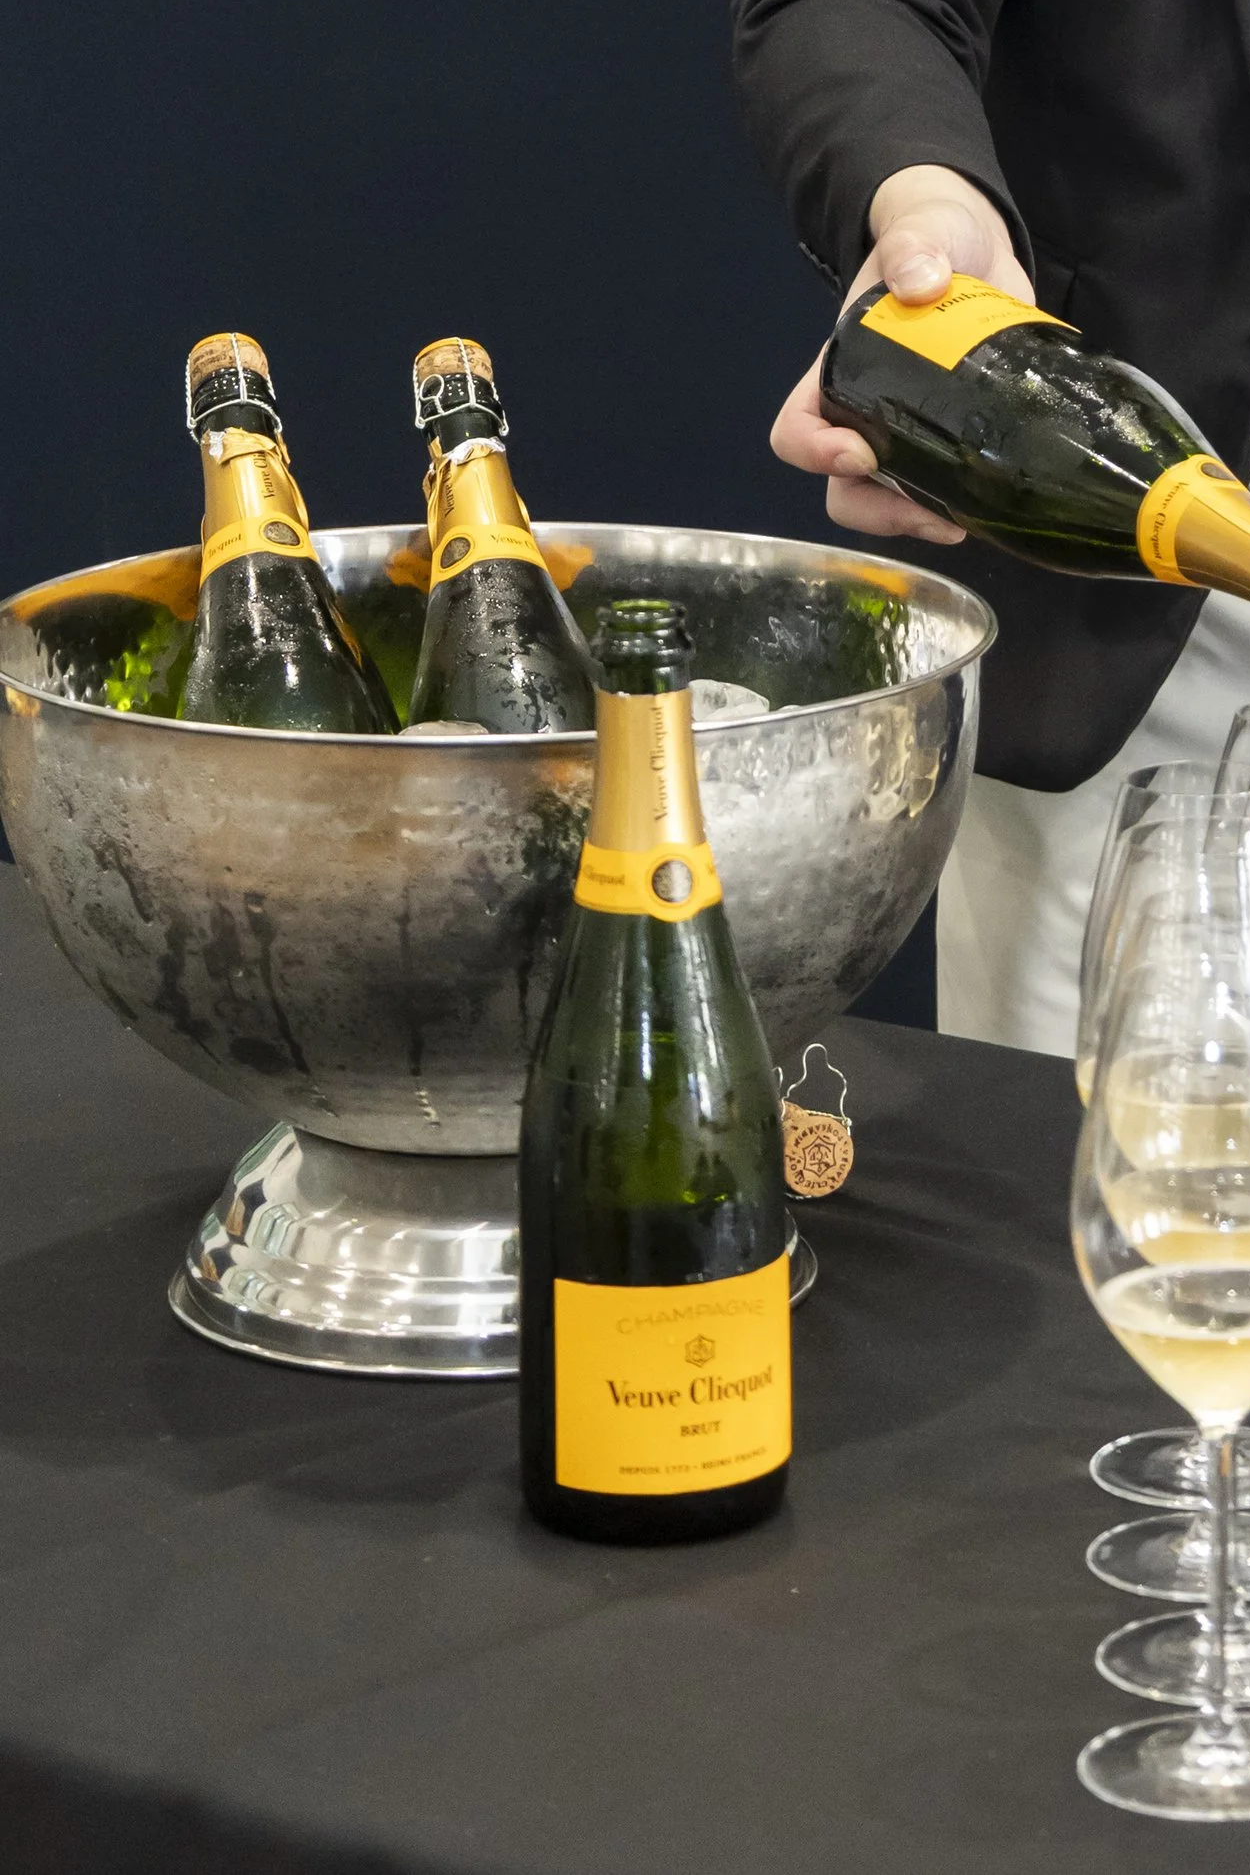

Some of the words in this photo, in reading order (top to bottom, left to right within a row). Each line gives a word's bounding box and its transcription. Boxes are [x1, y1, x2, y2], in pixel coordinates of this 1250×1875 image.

[262, 471, 276, 499] Veuve
[444, 484, 456, 518] Veuve
[1163, 482, 1189, 510] Veuve
[1151, 512, 1167, 560] Clicquot
[651, 705, 668, 771] Clicquot
[654, 776, 668, 821] Veuve
[615, 1298, 766, 1335] CHAMPAGNE
[606, 1378, 682, 1408] Veuve
[690, 1364, 774, 1407] Clicquot
[680, 1420, 721, 1437] BRUT
